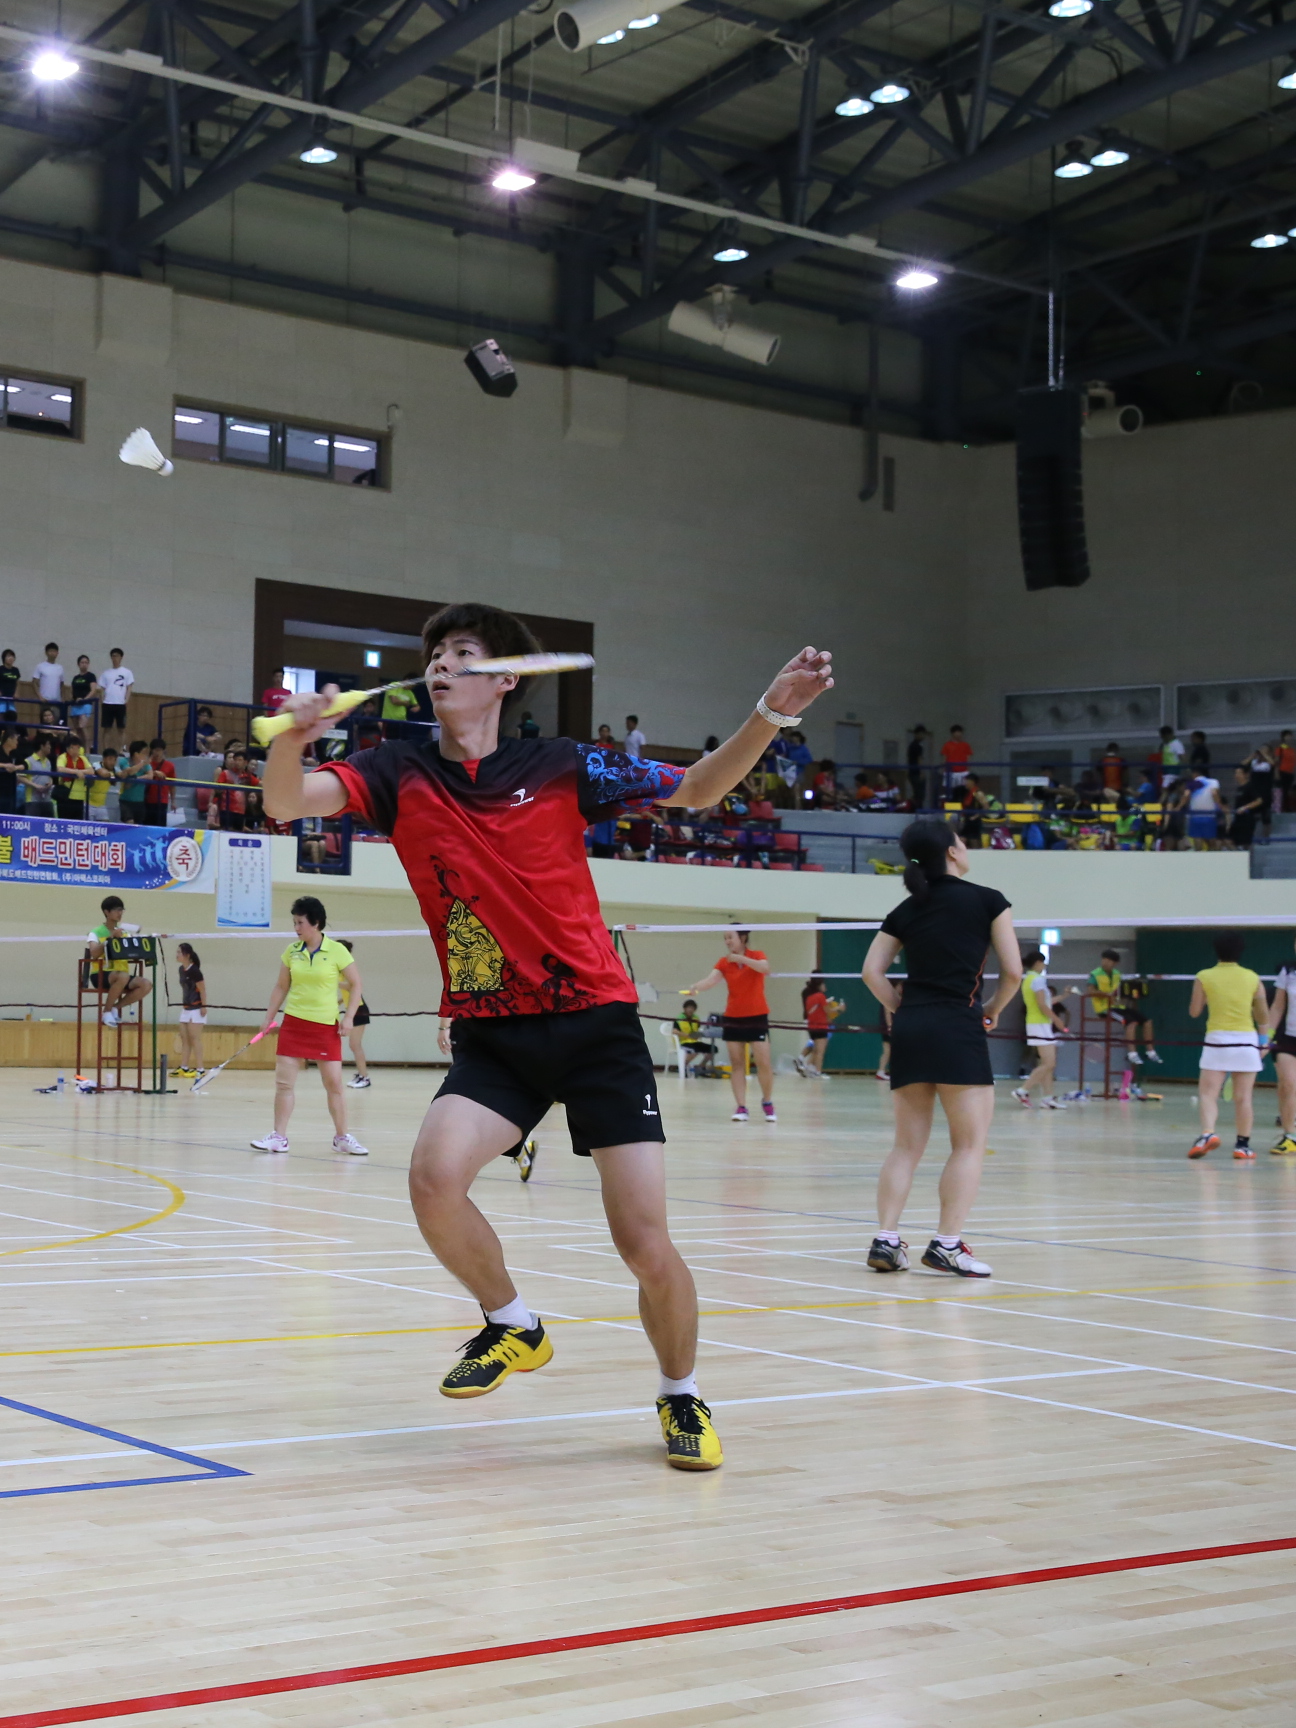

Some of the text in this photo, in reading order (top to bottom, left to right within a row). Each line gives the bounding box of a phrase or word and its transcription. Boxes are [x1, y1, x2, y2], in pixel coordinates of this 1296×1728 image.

[2, 820, 31, 831] 11:00시
[44, 823, 58, 833] 장소
[67, 824, 108, 837] 국민체육센터
[20, 836, 127, 872] 배드민턴대회
[175, 844, 192, 870] 축
